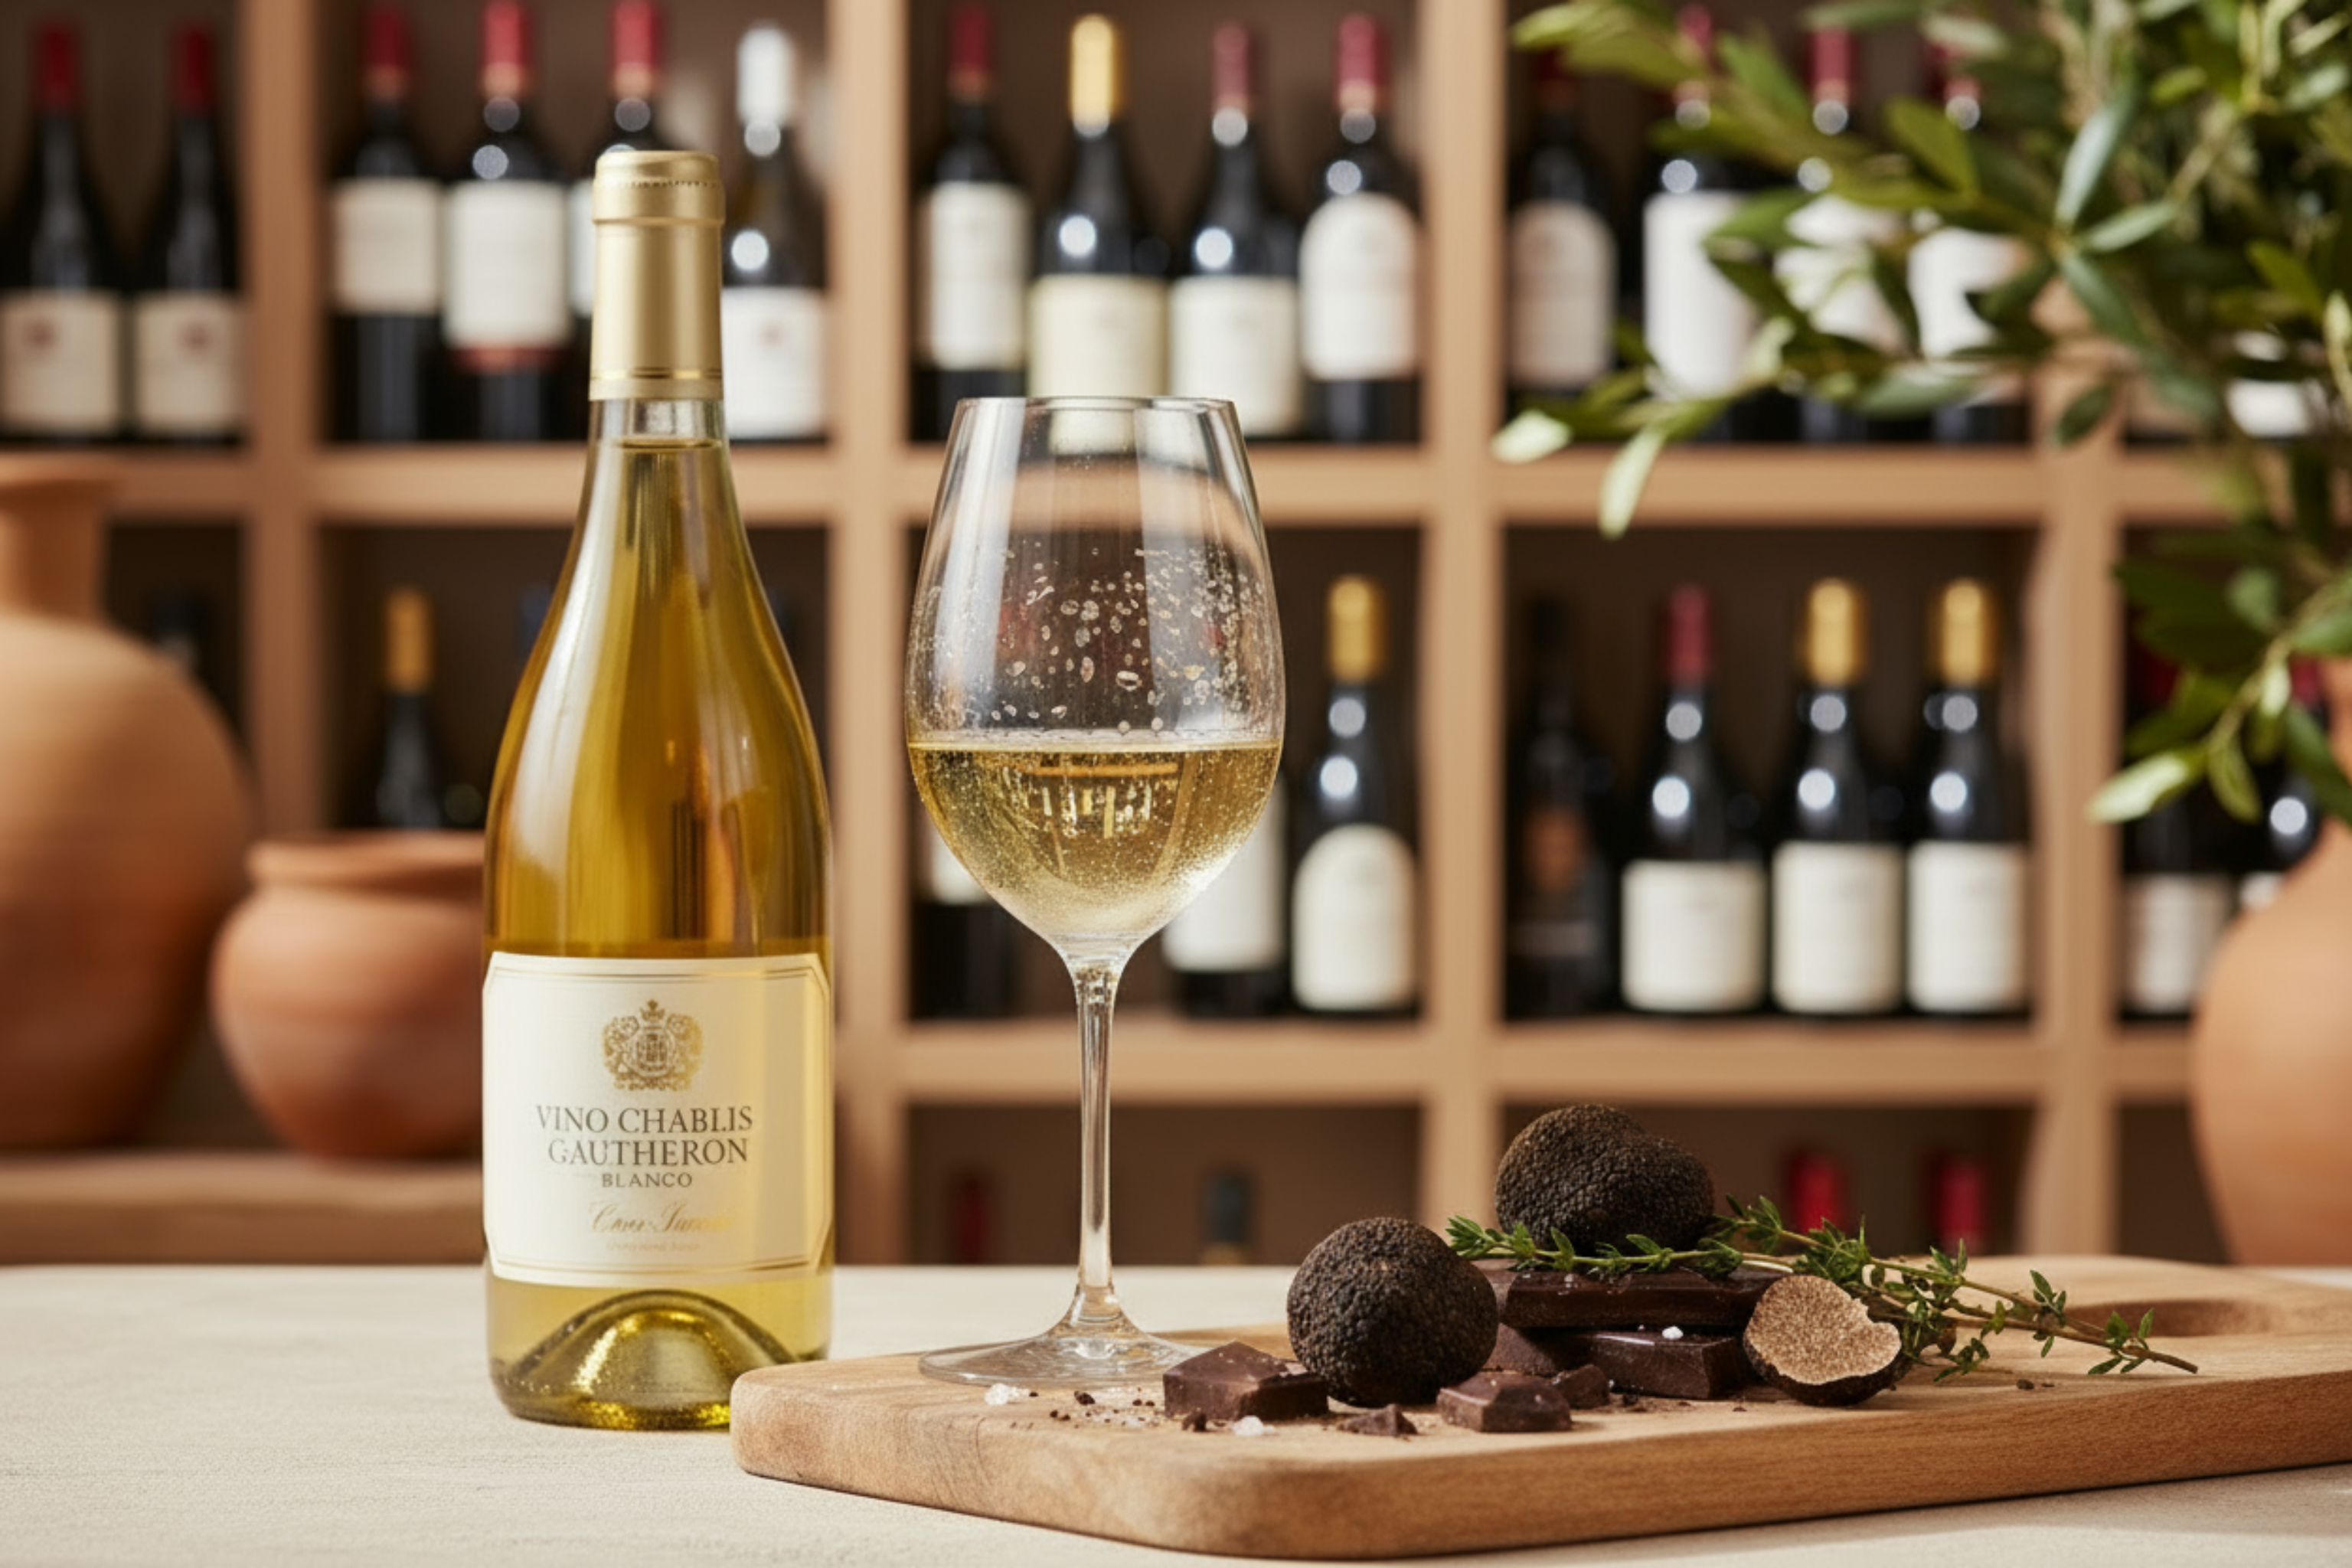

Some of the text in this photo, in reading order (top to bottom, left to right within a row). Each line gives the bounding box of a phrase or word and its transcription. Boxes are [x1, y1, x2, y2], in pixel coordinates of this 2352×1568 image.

[537, 1106, 753, 1134] VINO CHABLIS
[548, 1138, 748, 1166] GAUTHERON
[603, 1172, 693, 1187] BLANCO
